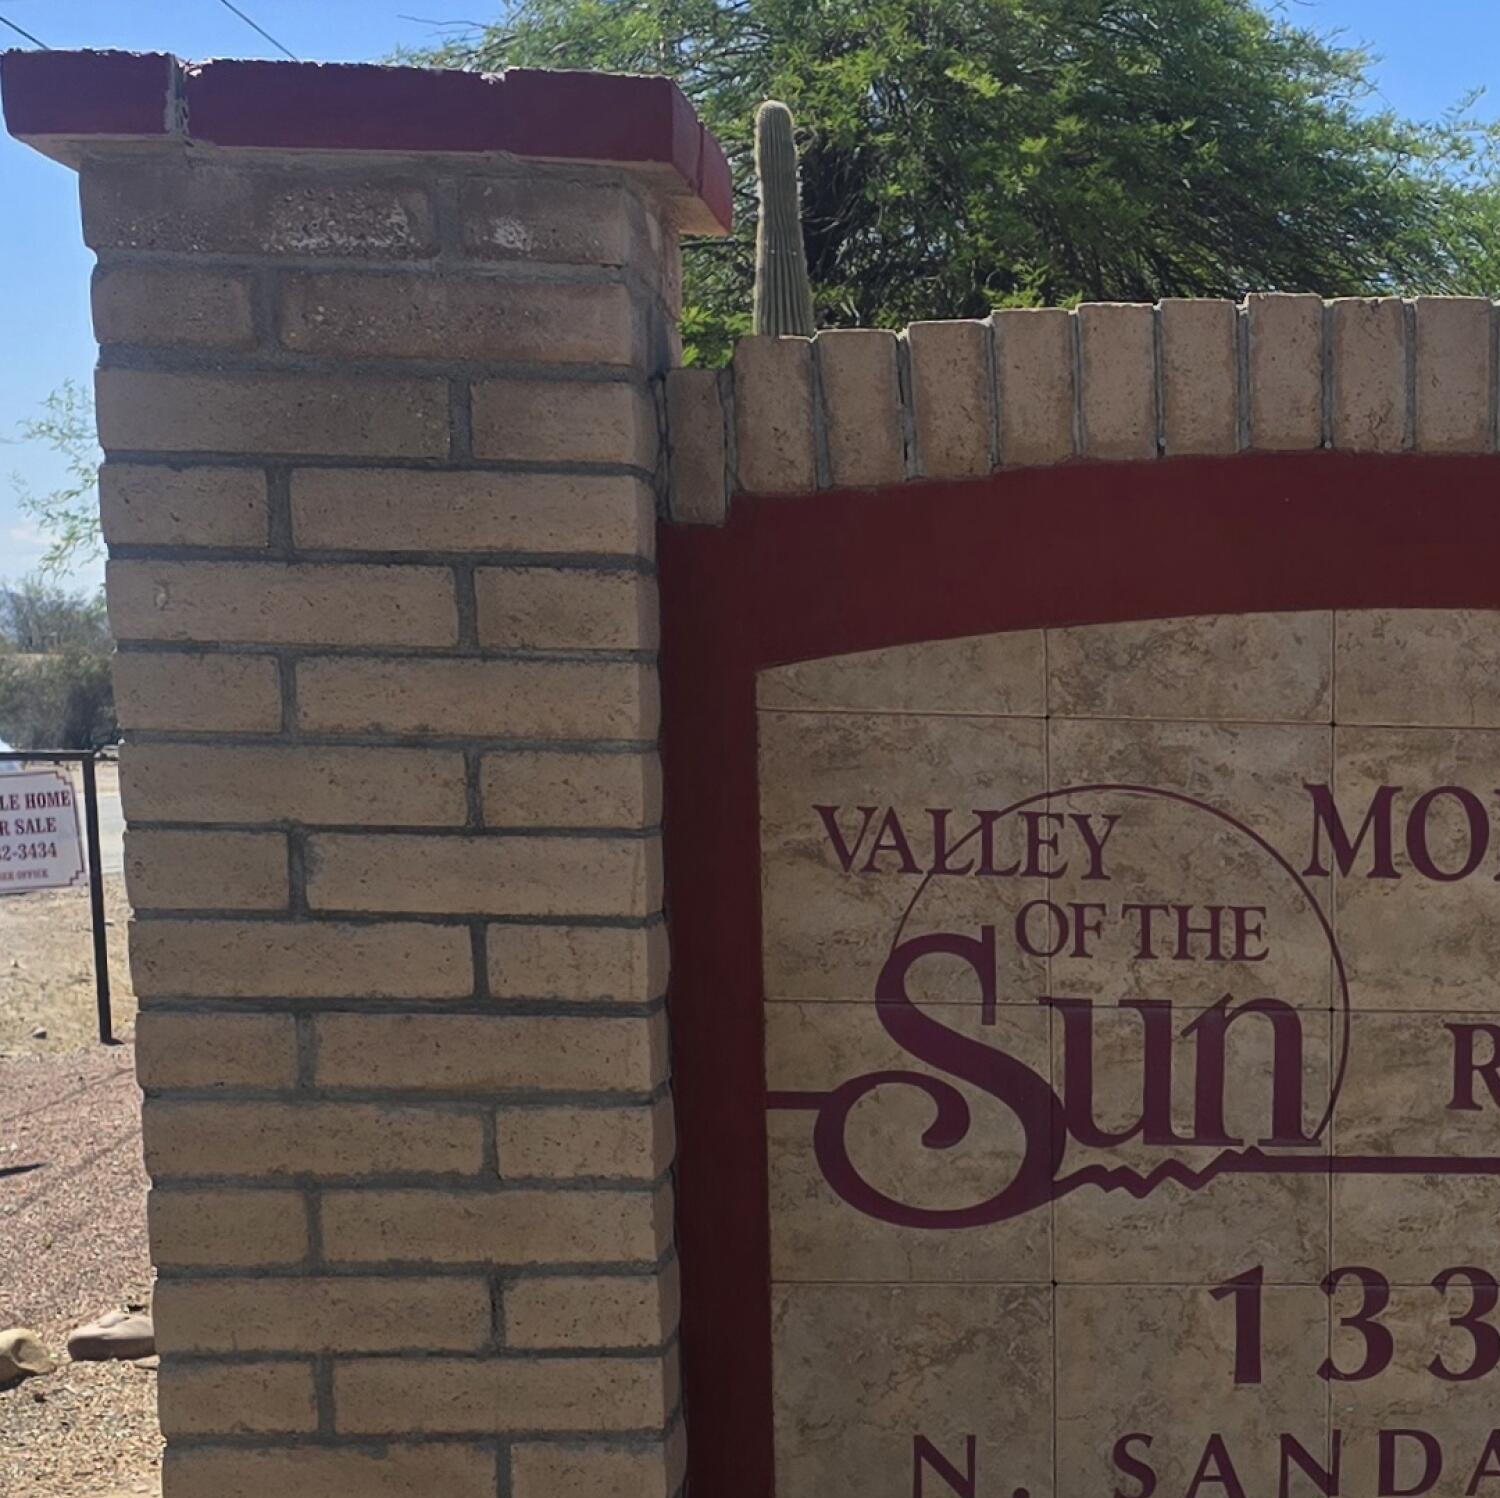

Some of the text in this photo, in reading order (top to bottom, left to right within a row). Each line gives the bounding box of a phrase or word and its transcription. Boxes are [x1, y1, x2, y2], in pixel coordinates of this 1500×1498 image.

[14, 816, 57, 836] SALE
[24, 790, 71, 810] HOME
[813, 804, 1122, 881] VALLEY
[1014, 899, 1270, 962] OF THE
[813, 924, 1321, 1229] Sun
